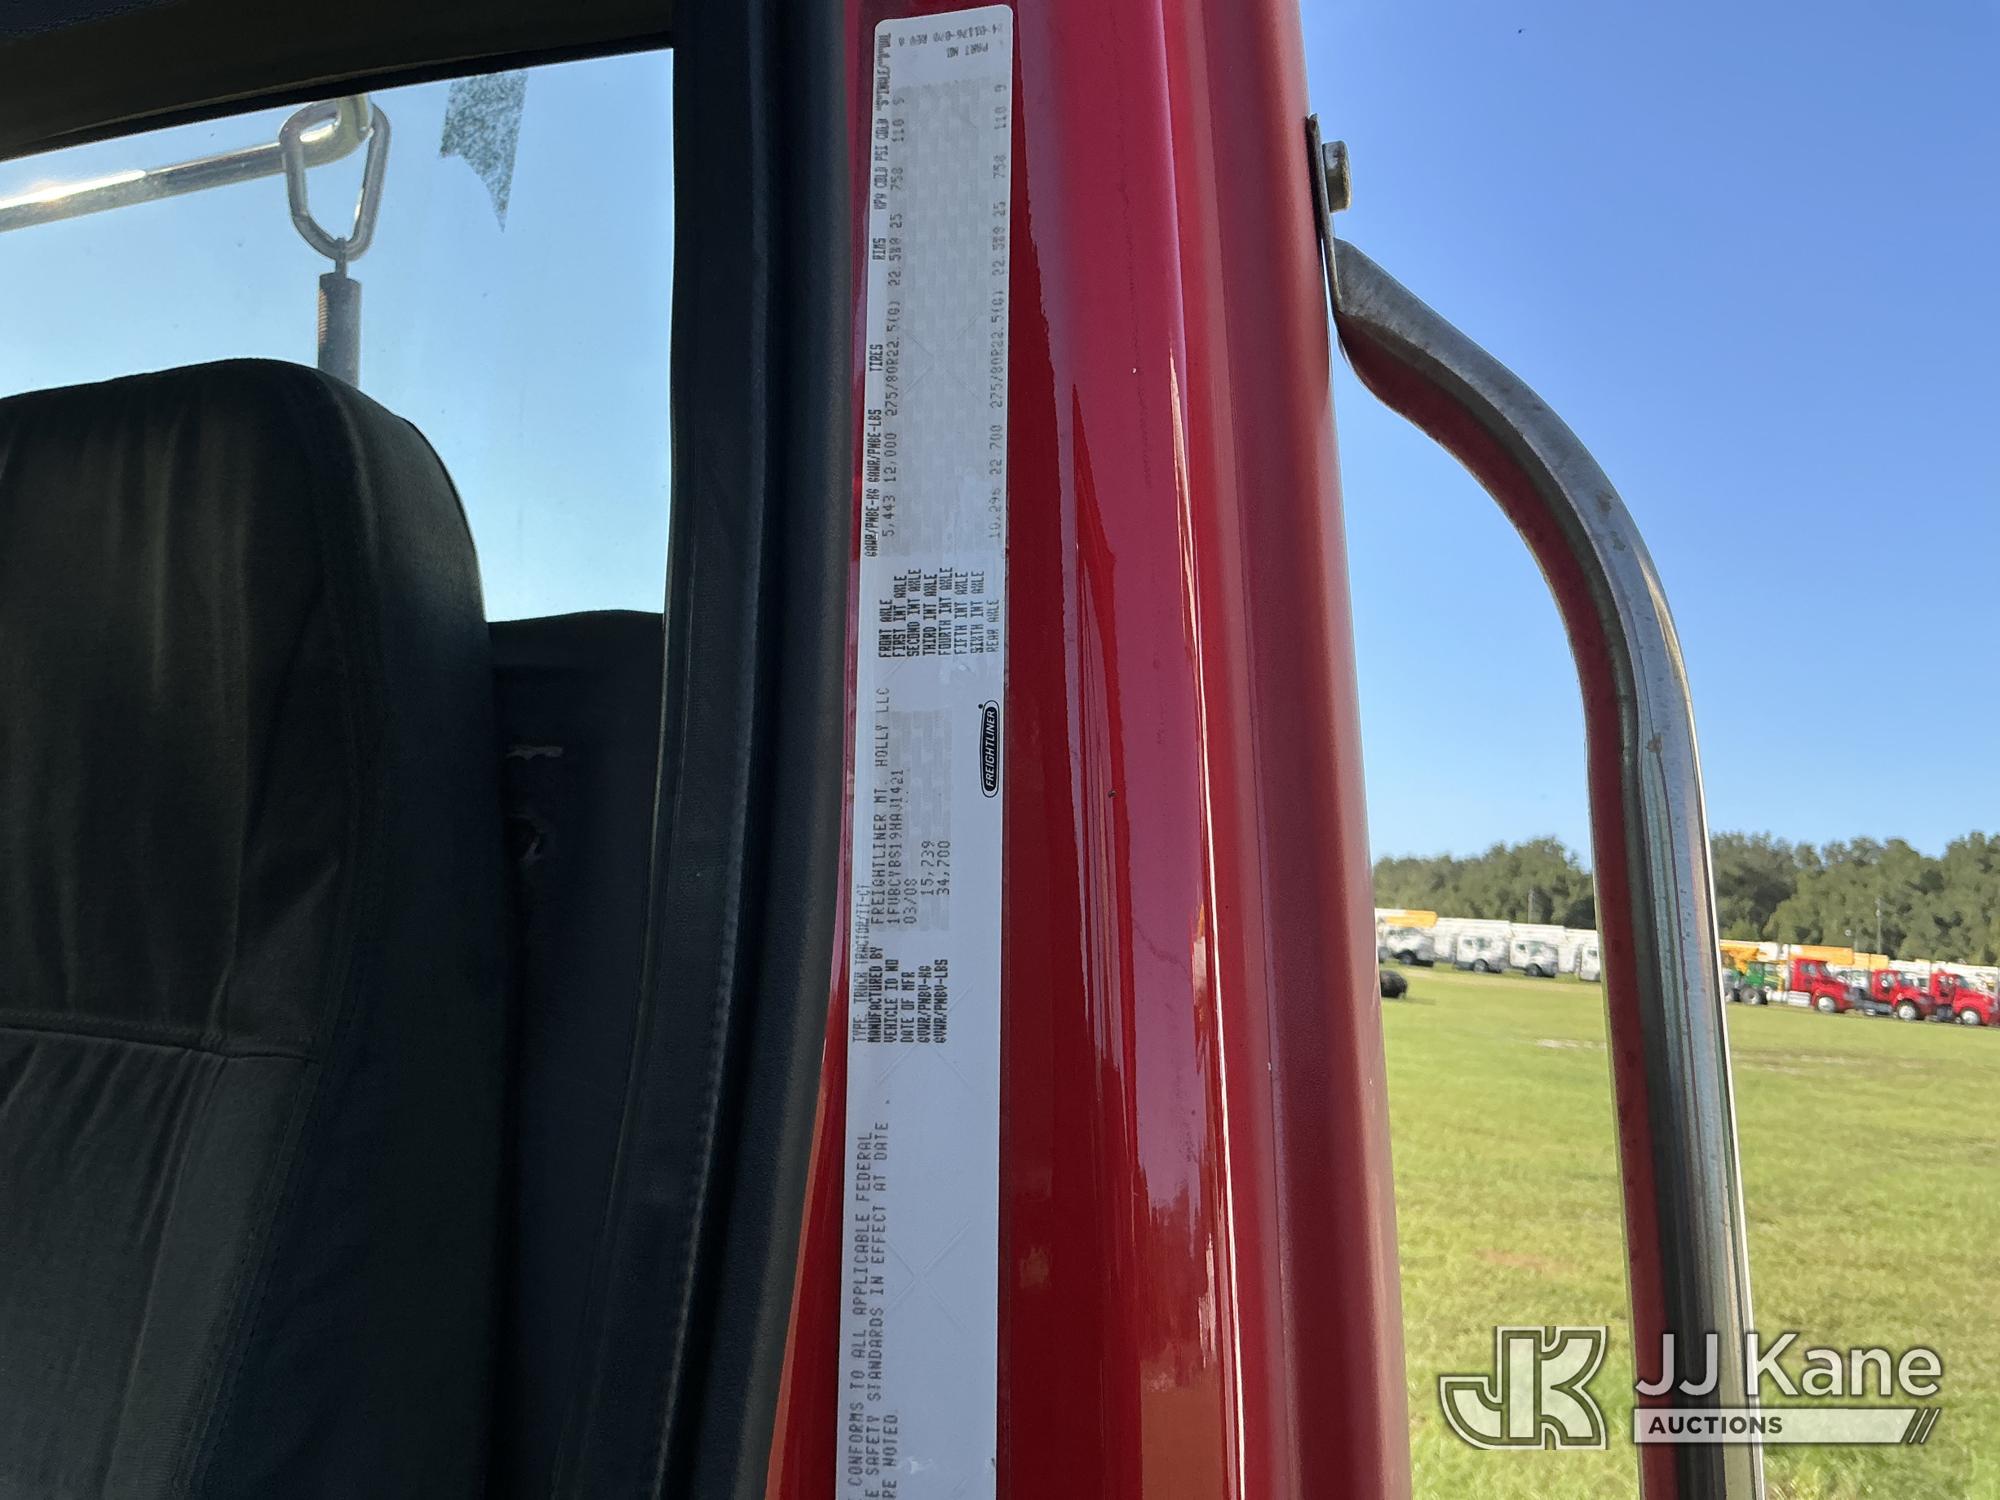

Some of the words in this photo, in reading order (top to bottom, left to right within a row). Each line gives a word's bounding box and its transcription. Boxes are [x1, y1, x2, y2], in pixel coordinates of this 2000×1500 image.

[874, 145, 888, 161] PSI
[872, 238, 886, 260] RIMS
[869, 344, 883, 372] TIRES
[884, 433, 898, 483] 12,000
[882, 495, 896, 537] 5,443
[894, 575, 907, 598] AXLE
[908, 568, 921, 592] AXLE
[924, 574, 937, 597] AXLE
[939, 567, 953, 590] AXLE
[955, 572, 968, 595] AXLE
[971, 571, 984, 594] AXLE
[880, 600, 893, 622] AXLE
[894, 604, 906, 622] INT
[908, 598, 920, 616] INT
[924, 603, 936, 620] INT
[939, 596, 952, 614] INT
[954, 600, 968, 619] INT
[971, 600, 983, 618] INT
[987, 600, 999, 622] AXLE
[878, 629, 892, 657] FRONT
[893, 629, 906, 657] FIRST
[907, 622, 920, 657] SECOND
[923, 627, 936, 656] THIRD
[938, 620, 951, 656] FOURTH
[954, 625, 967, 655] FIFTH
[970, 624, 983, 654] SIXTH
[986, 629, 999, 653] REAR
[876, 687, 889, 712] LLC
[875, 726, 888, 767] HOLLY
[985, 710, 995, 787] FREIGHTLINER
[872, 814, 886, 924] FREIGHTLINER
[920, 840, 935, 896] 15,739
[937, 840, 950, 896] 34,700
[870, 947, 883, 960] BY
[885, 959, 898, 972] NO
[885, 978, 898, 991] ID
[902, 972, 915, 991] MFR
[868, 966, 883, 1042] MANUFACTURED
[902, 998, 914, 1010] OF
[885, 998, 898, 1042] VEHICLE
[902, 1017, 914, 1042] DATE
[874, 1122, 888, 1160] DATE
[857, 1132, 872, 1201] FEDERAL
[874, 1175, 886, 1191] AT
[871, 1206, 886, 1263] EFFECT
[853, 1214, 870, 1315] APPLICABLE
[870, 1276, 883, 1295] IN
[851, 1330, 866, 1357] ALL
[867, 1308, 883, 1401] STANDARDS
[850, 1371, 865, 1389] TO
[848, 1402, 864, 1486] CONFORMS
[866, 1415, 880, 1476] SAFETY
